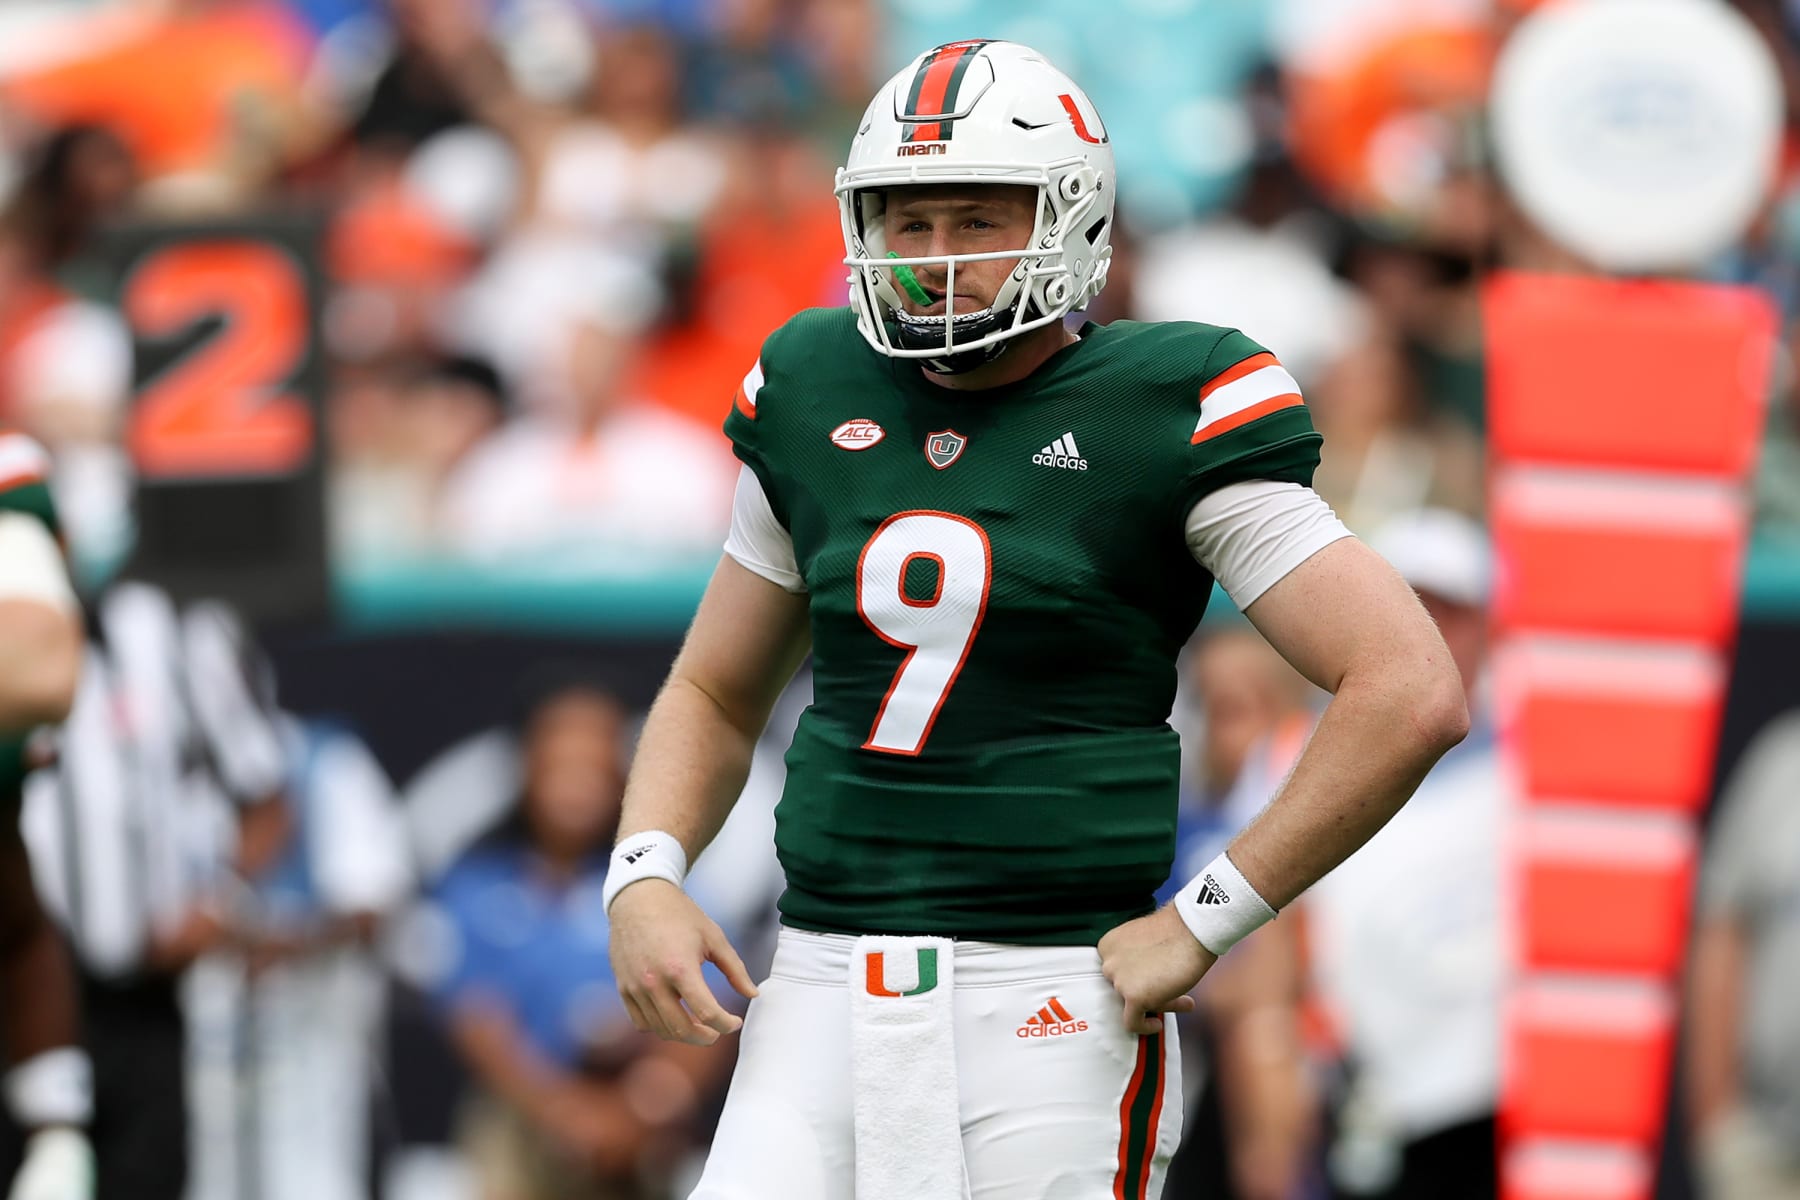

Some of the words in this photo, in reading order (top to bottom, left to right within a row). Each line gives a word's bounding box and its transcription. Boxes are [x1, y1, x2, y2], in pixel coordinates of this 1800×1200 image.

[124, 238, 313, 480] 2
[837, 426, 878, 438] ACC
[932, 439, 957, 455] U
[1032, 452, 1088, 471] adidas
[856, 509, 993, 757] 9
[1204, 873, 1230, 904] adidas
[866, 948, 938, 997] U
[1016, 1018, 1088, 1038] adidas
